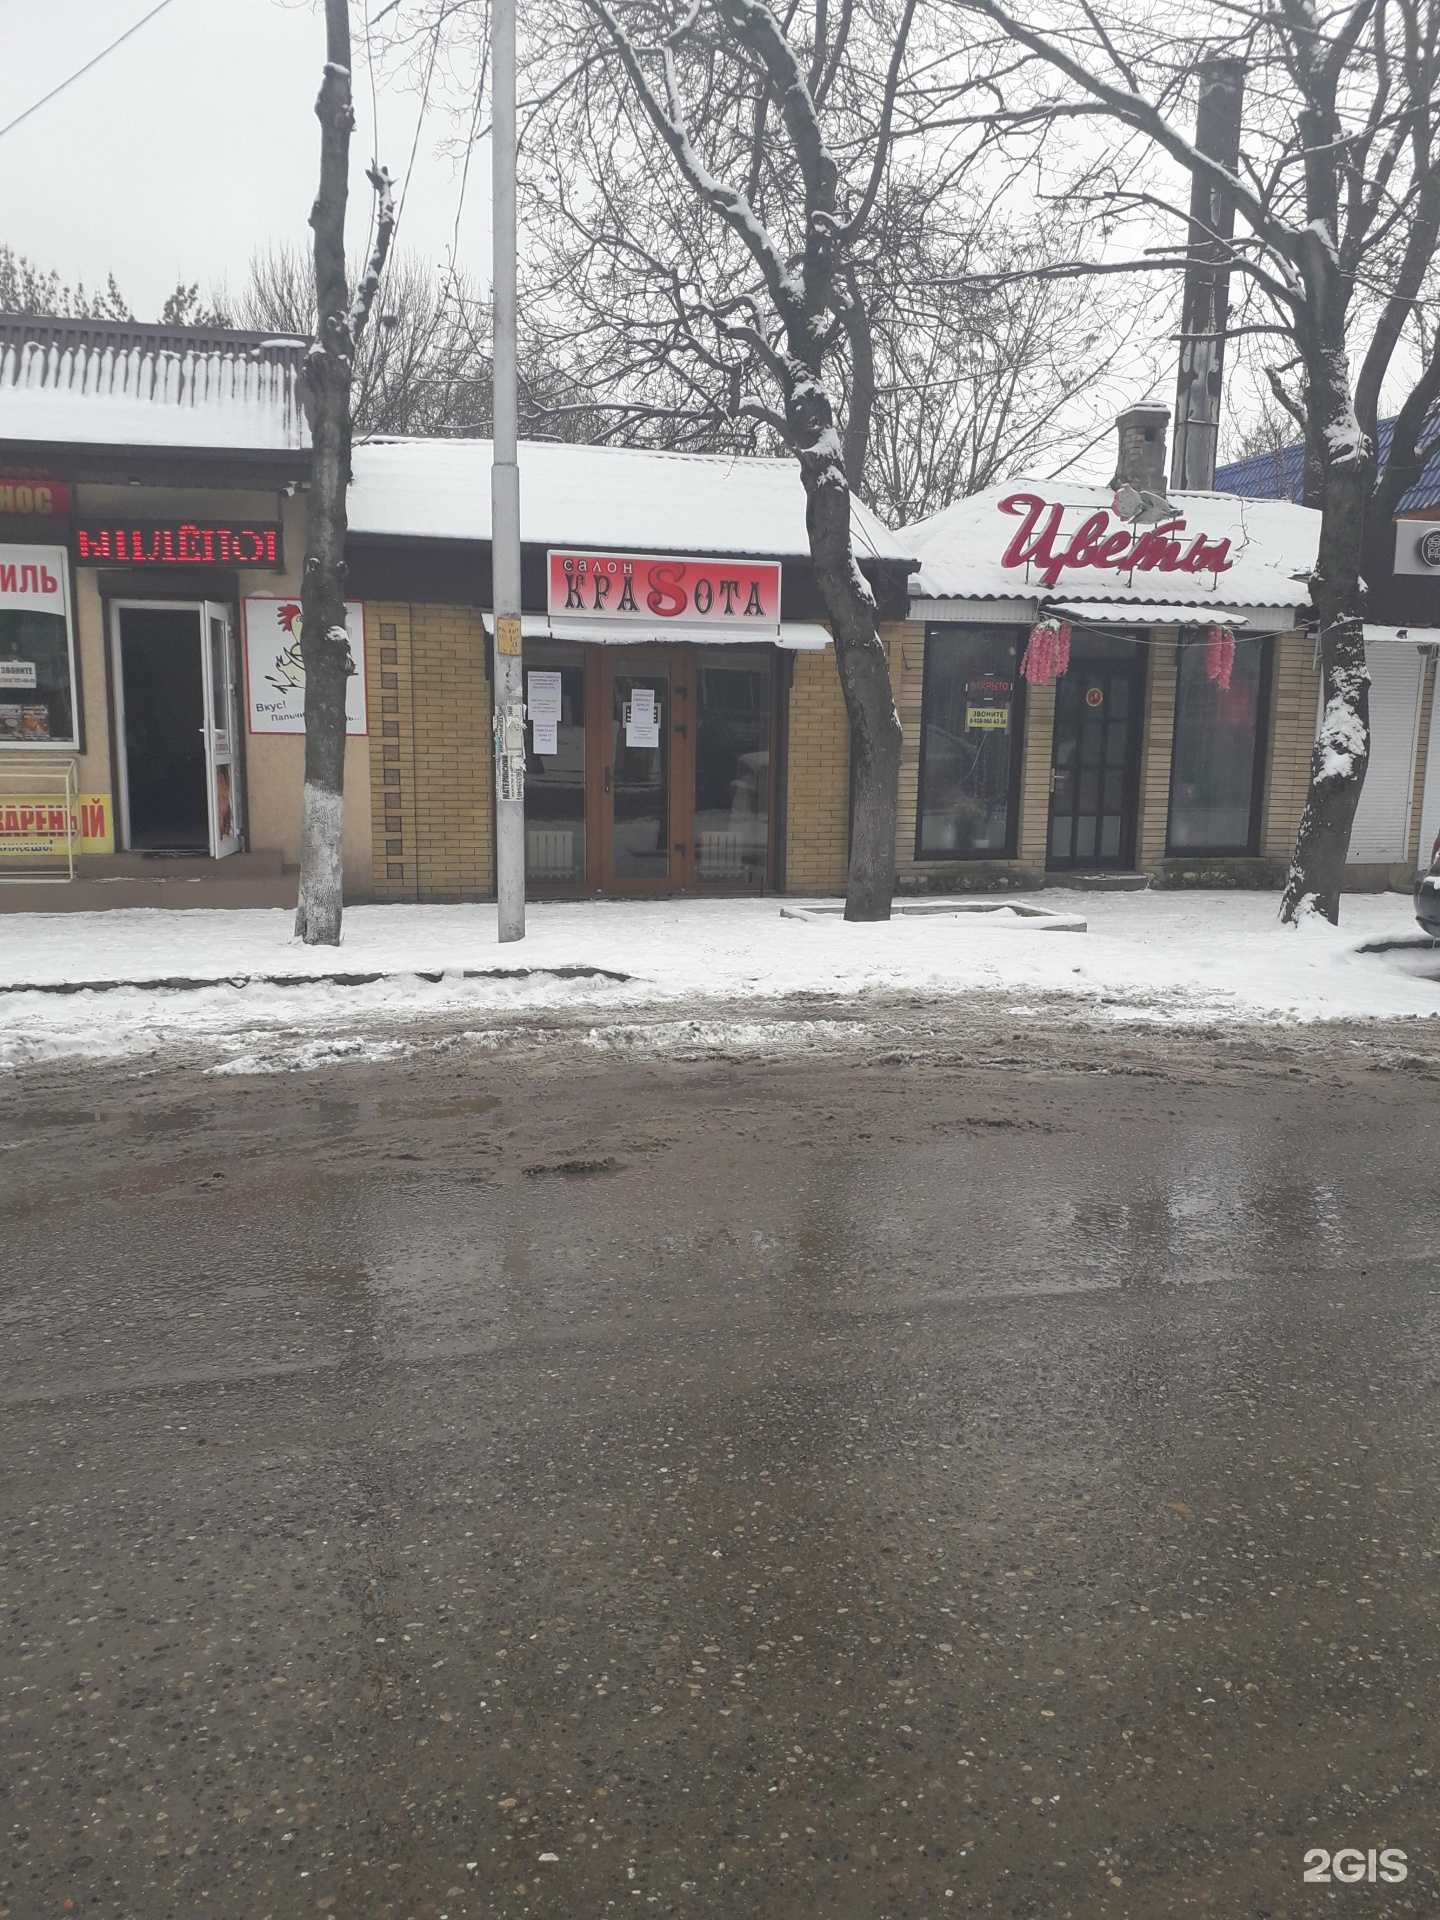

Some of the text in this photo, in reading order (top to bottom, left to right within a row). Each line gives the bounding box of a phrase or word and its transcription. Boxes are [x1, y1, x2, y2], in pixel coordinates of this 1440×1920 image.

[997, 493, 1233, 589] Цветы
[562, 559, 633, 574] салон
[256, 700, 287, 712] Вкус!
[971, 711, 1005, 719] ЗВОНИТЕ
[0, 798, 105, 837] АРЕНЫЙ
